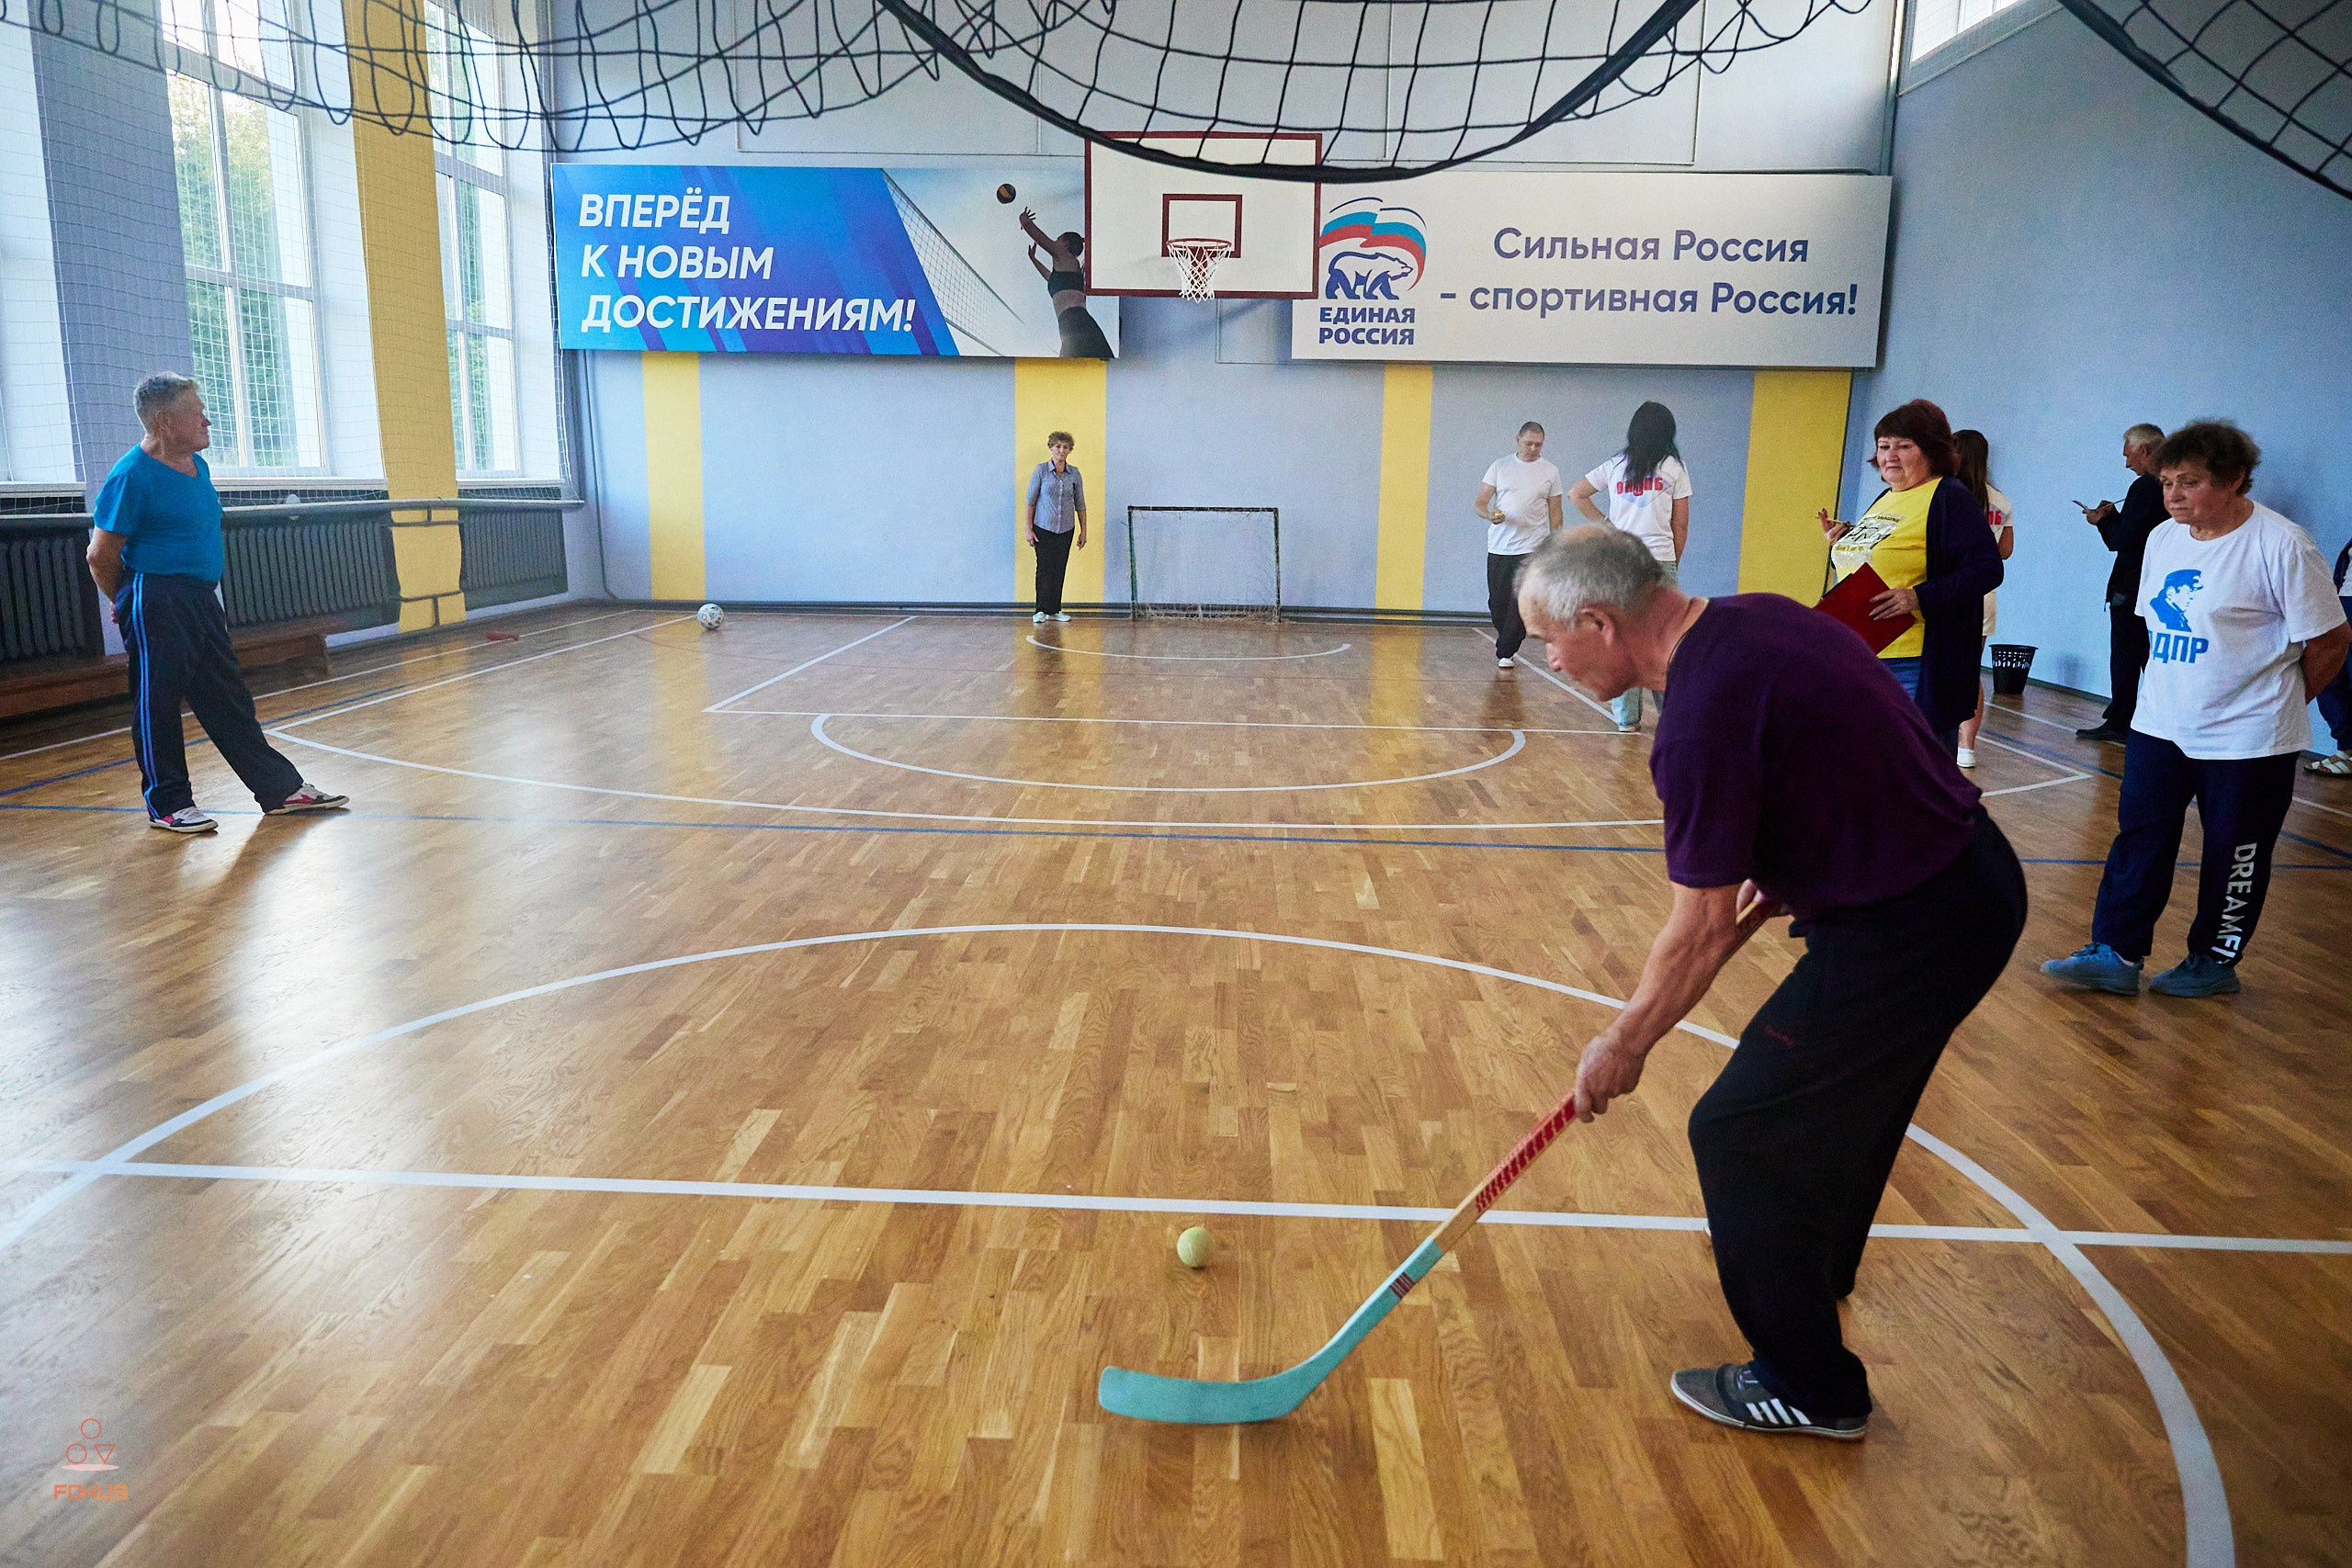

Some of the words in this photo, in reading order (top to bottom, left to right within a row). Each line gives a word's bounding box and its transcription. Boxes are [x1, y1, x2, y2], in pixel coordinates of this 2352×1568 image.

[579, 186, 730, 235] ВПЕРЁД
[581, 245, 606, 278] К
[617, 245, 775, 280] НОВЫМ
[1494, 227, 1660, 262] Сильная
[1673, 231, 1809, 264] Россия
[581, 295, 916, 333] ДОСТИЖЕНИЯМ!
[1319, 308, 1416, 326] ЕДИНАЯ
[1470, 287, 1698, 319] спортивная
[1711, 283, 1860, 316] Россия!
[1319, 328, 1415, 346] РОССИЯ
